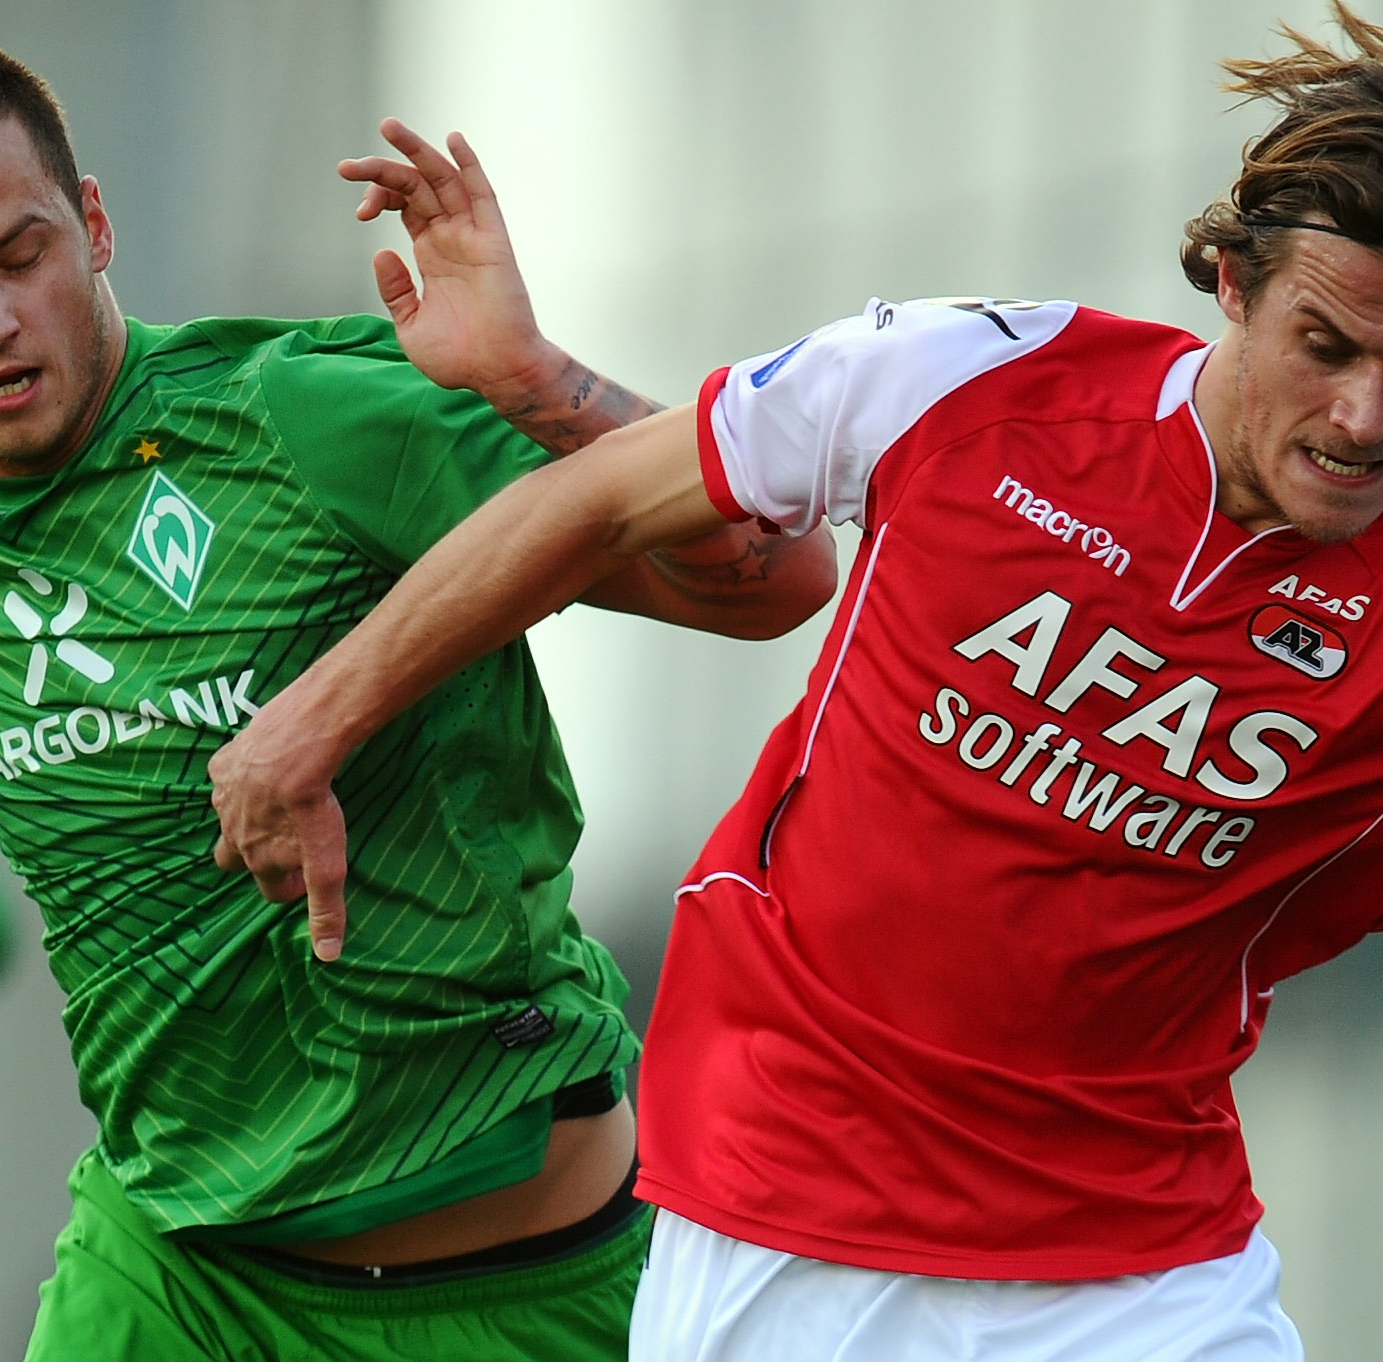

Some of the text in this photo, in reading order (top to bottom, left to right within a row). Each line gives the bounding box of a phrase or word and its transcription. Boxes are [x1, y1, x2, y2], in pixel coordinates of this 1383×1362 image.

[992, 474, 1132, 577] macron
[1262, 618, 1324, 671] AZ
[1266, 573, 1372, 621] AFAS
[952, 588, 1319, 801] AFAS
[918, 686, 1257, 869] software
